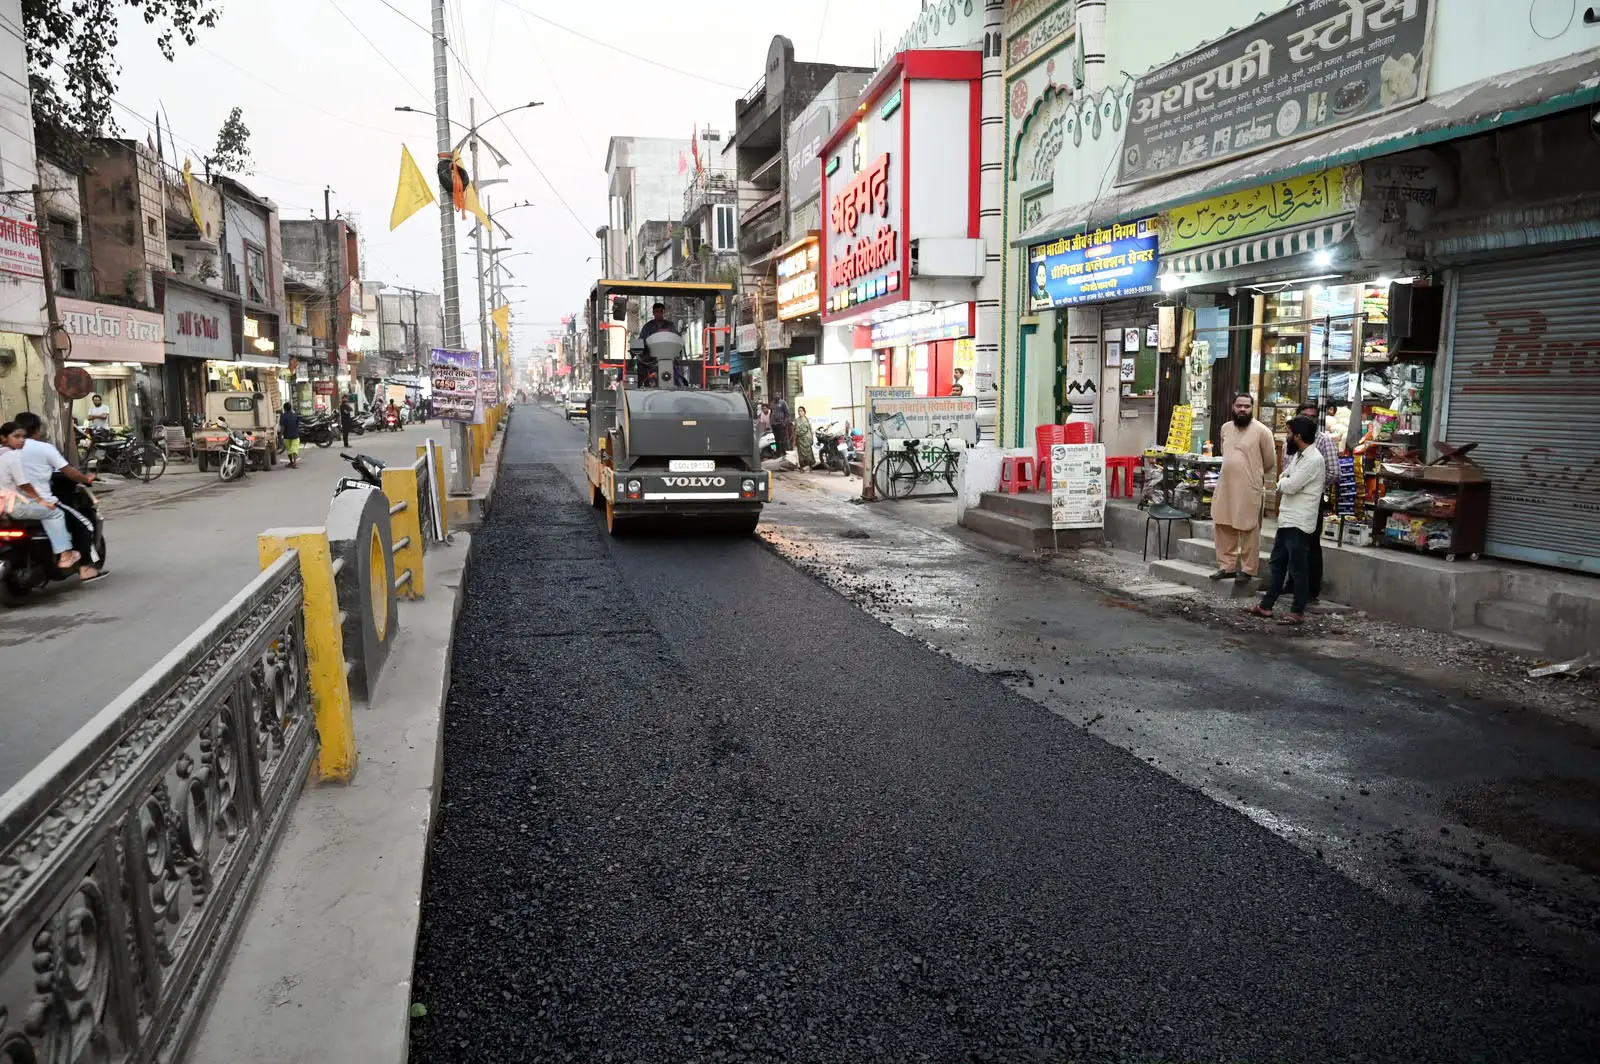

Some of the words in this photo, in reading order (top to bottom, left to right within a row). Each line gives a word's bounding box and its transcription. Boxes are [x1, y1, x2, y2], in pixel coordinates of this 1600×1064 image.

[1132, 39, 1275, 124] अशरफी
[1046, 238, 1071, 257] भारतीय
[1071, 232, 1093, 250] जीवन
[1093, 228, 1112, 245] बीमा
[1113, 222, 1137, 242] निगम
[1051, 261, 1084, 280] प्रीमियम
[62, 307, 120, 338] सार्थक
[126, 312, 161, 343] सेल्स
[662, 477, 726, 487] VOLVO
